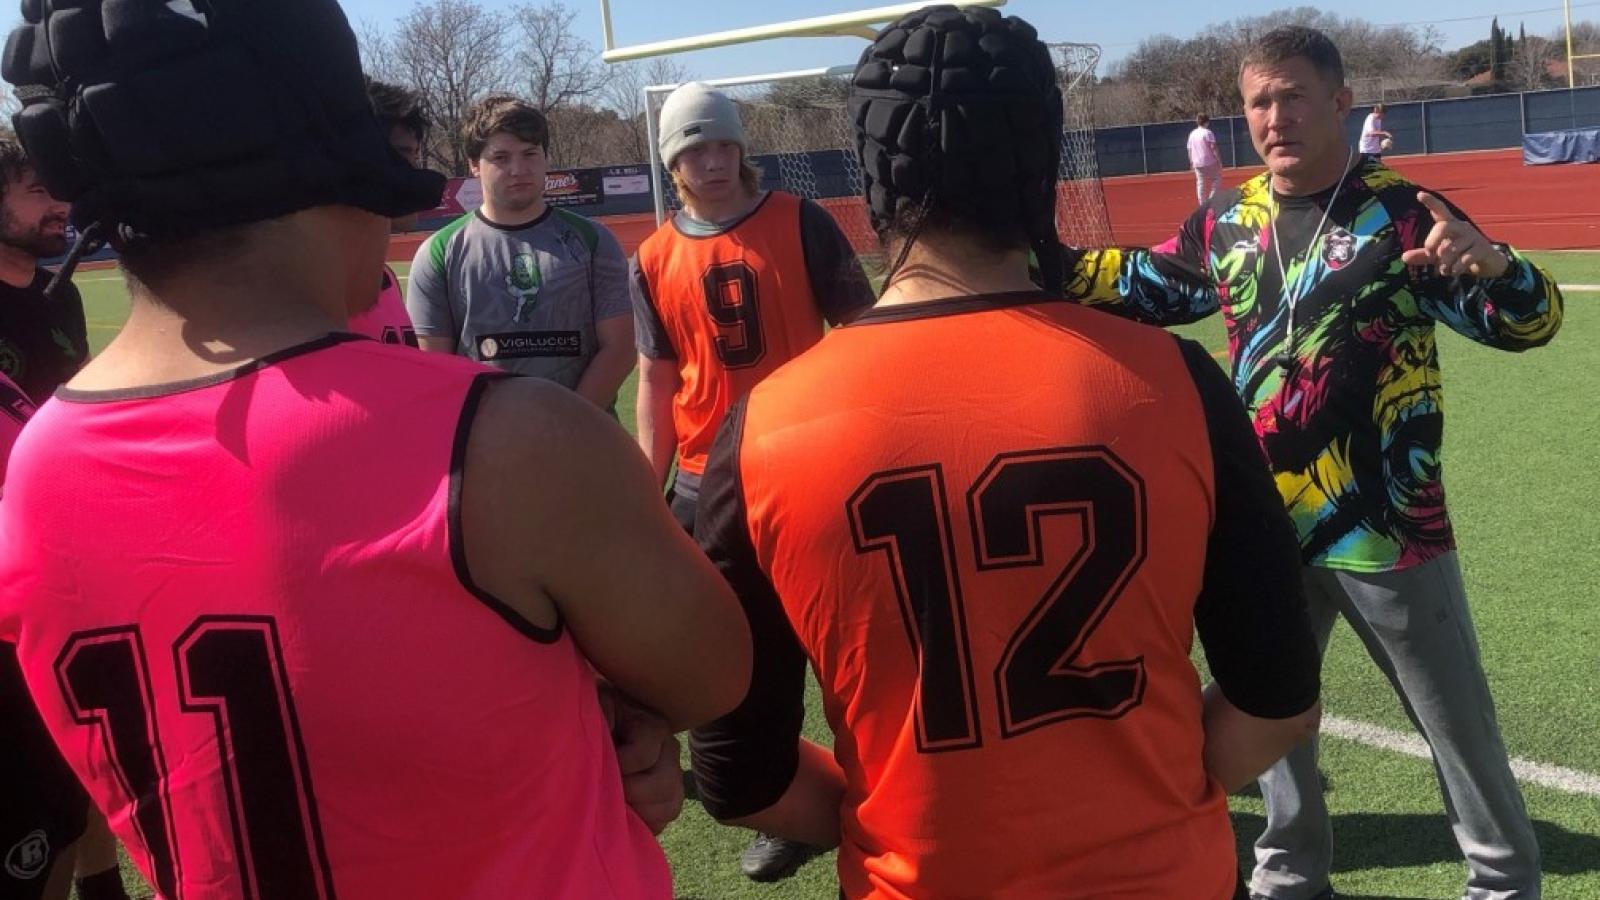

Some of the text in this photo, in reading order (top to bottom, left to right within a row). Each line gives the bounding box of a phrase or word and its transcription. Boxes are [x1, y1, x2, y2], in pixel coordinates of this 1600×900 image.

[701, 259, 766, 370] 9
[845, 444, 1148, 754] 12
[53, 614, 338, 900] 11
